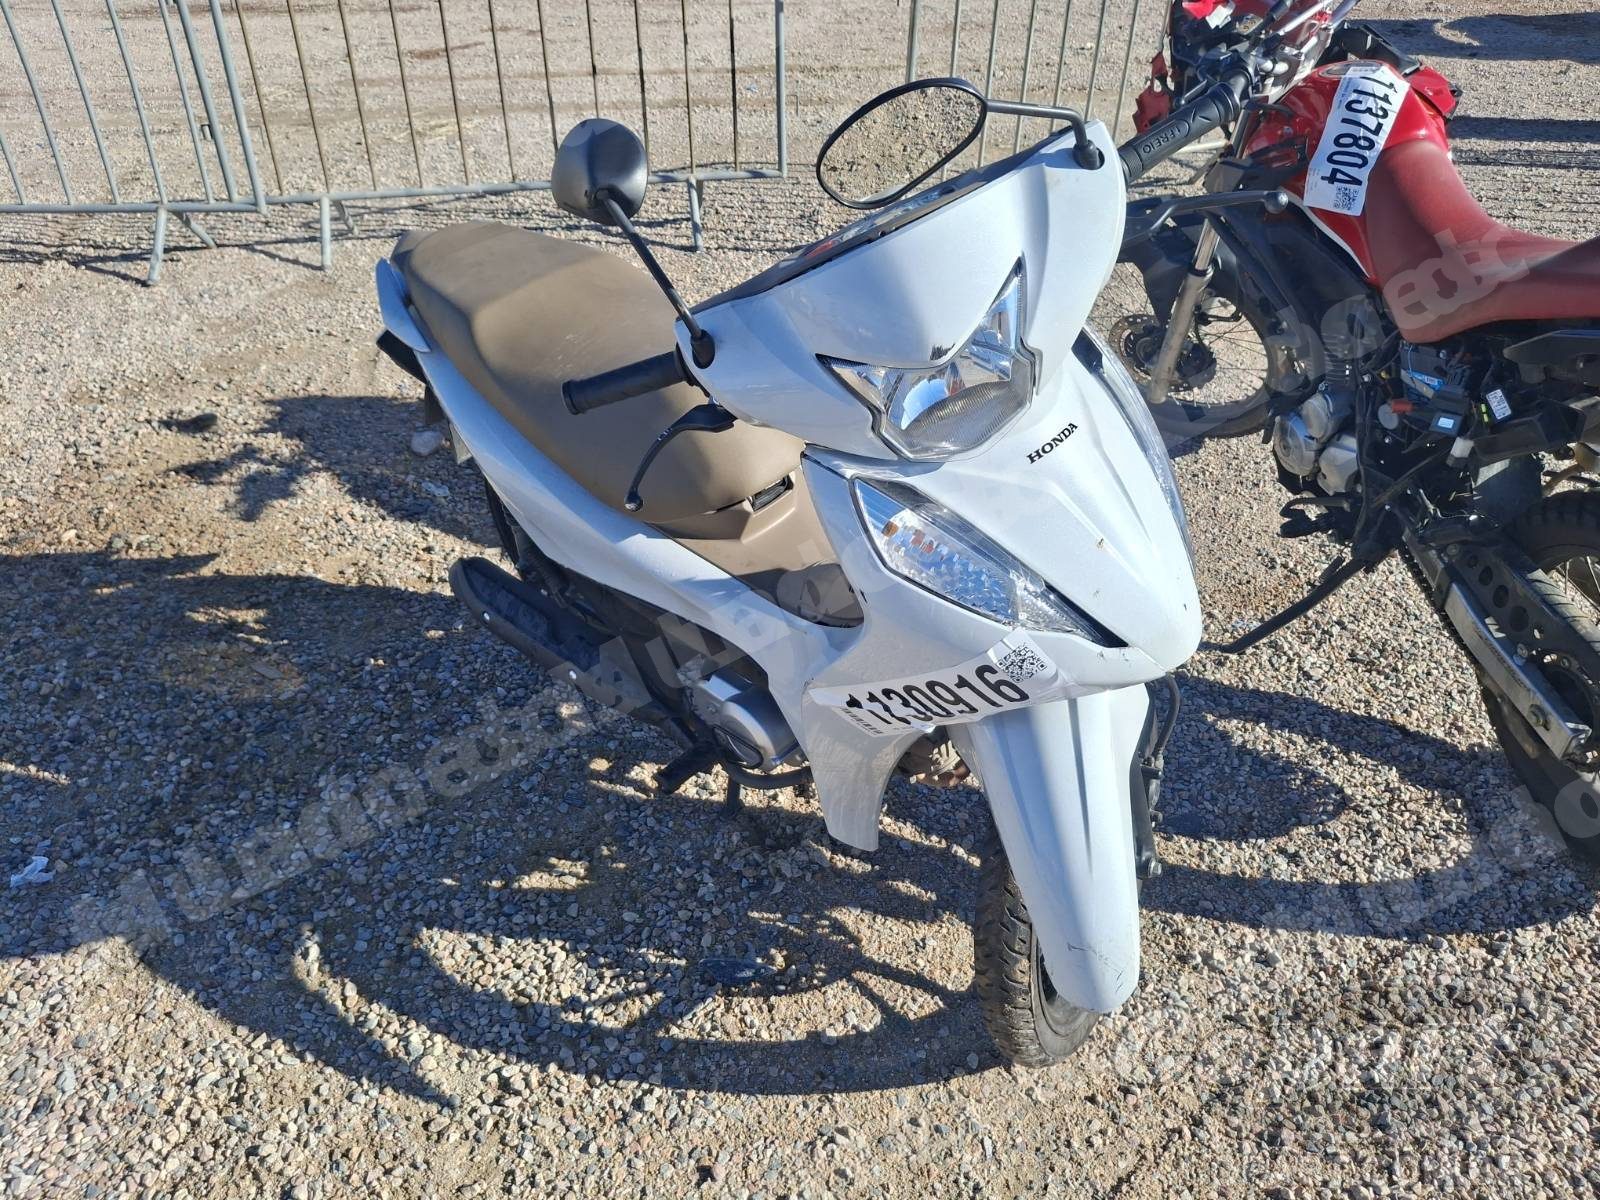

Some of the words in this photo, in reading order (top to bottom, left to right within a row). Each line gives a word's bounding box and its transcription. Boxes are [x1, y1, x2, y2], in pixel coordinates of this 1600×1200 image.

[1321, 76, 1398, 187] 1137804
[1026, 422, 1078, 464] HONDA
[846, 664, 1029, 725] 1130916
